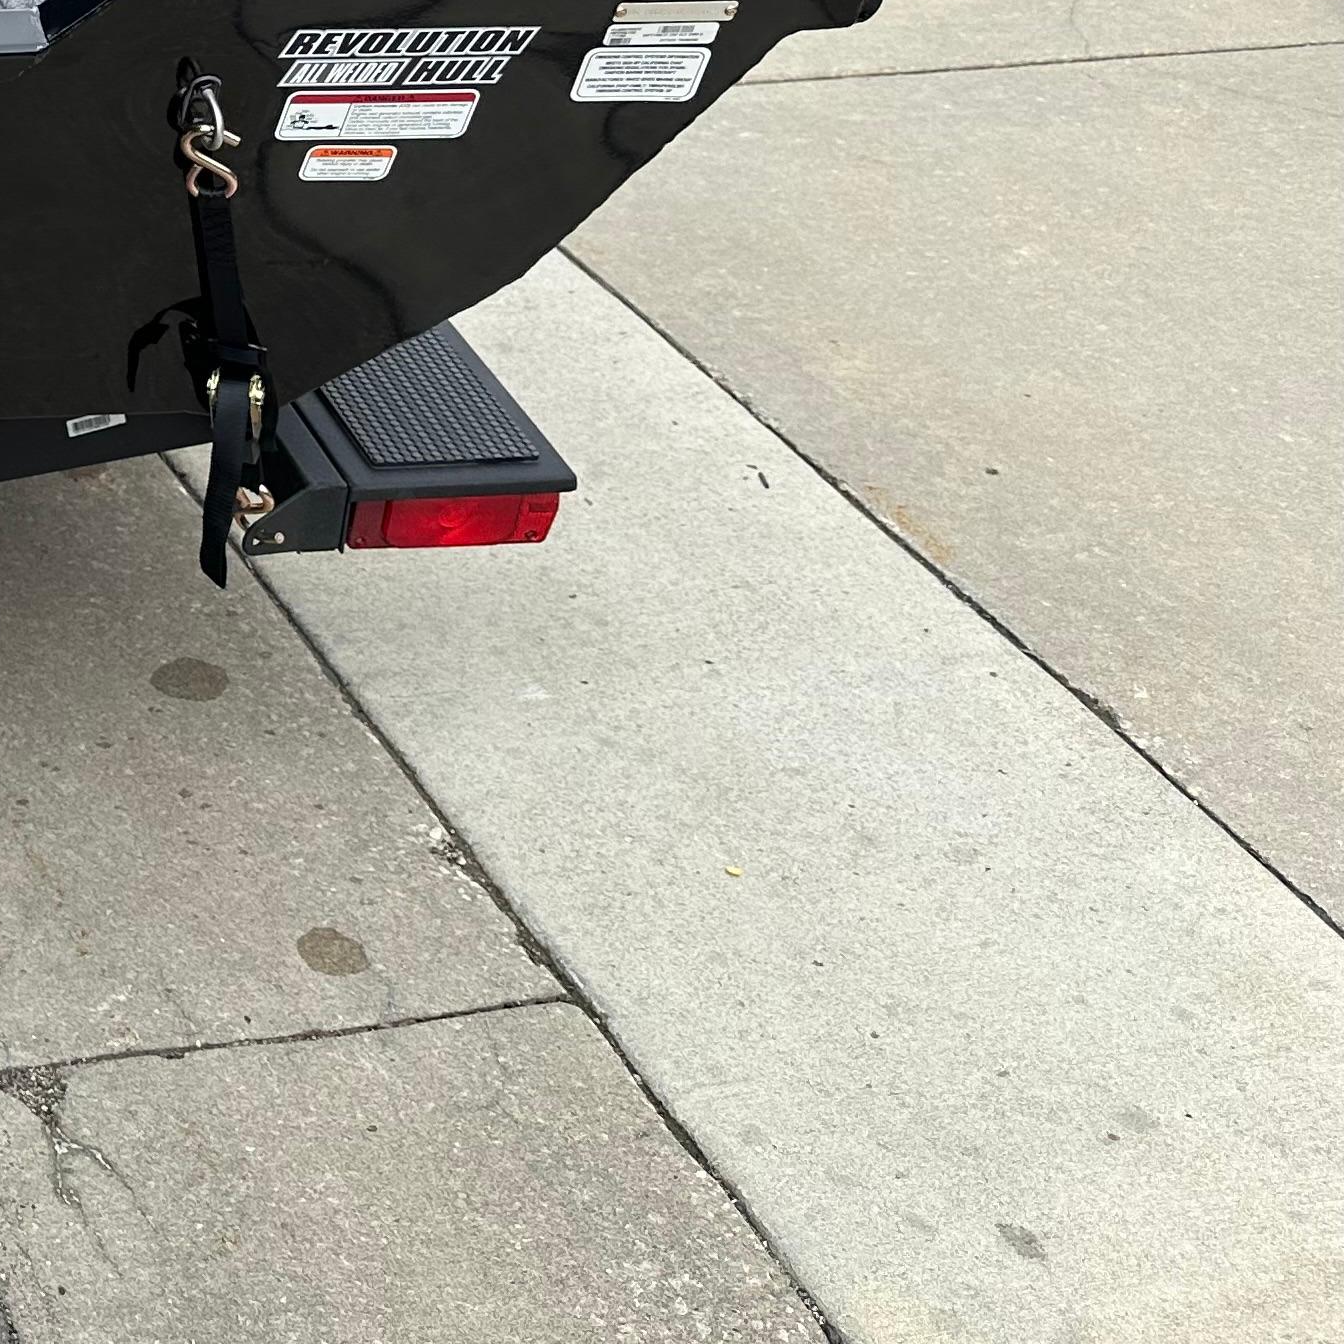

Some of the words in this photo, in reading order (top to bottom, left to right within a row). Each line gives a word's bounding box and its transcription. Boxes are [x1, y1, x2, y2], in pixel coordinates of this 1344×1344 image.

[283, 28, 541, 56] REVOLUTION
[289, 62, 327, 84] ALL
[326, 61, 404, 84] WELDED
[412, 57, 507, 84] HULL
